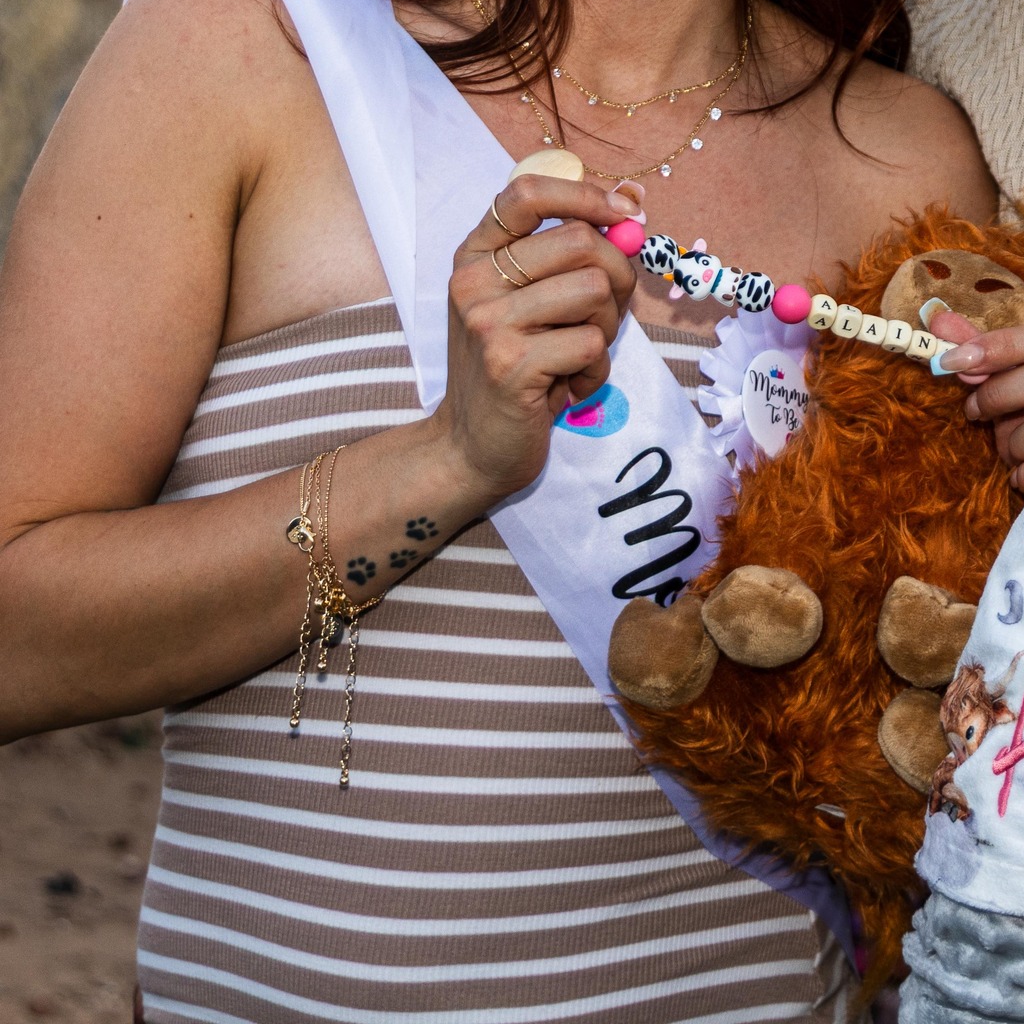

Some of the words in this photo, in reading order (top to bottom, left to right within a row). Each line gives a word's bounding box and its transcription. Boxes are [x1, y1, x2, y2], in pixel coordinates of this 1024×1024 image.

[815, 300, 950, 352] ALAIN
[750, 369, 809, 414] Mommy
[765, 403, 781, 424] To
[783, 407, 799, 431] Be
